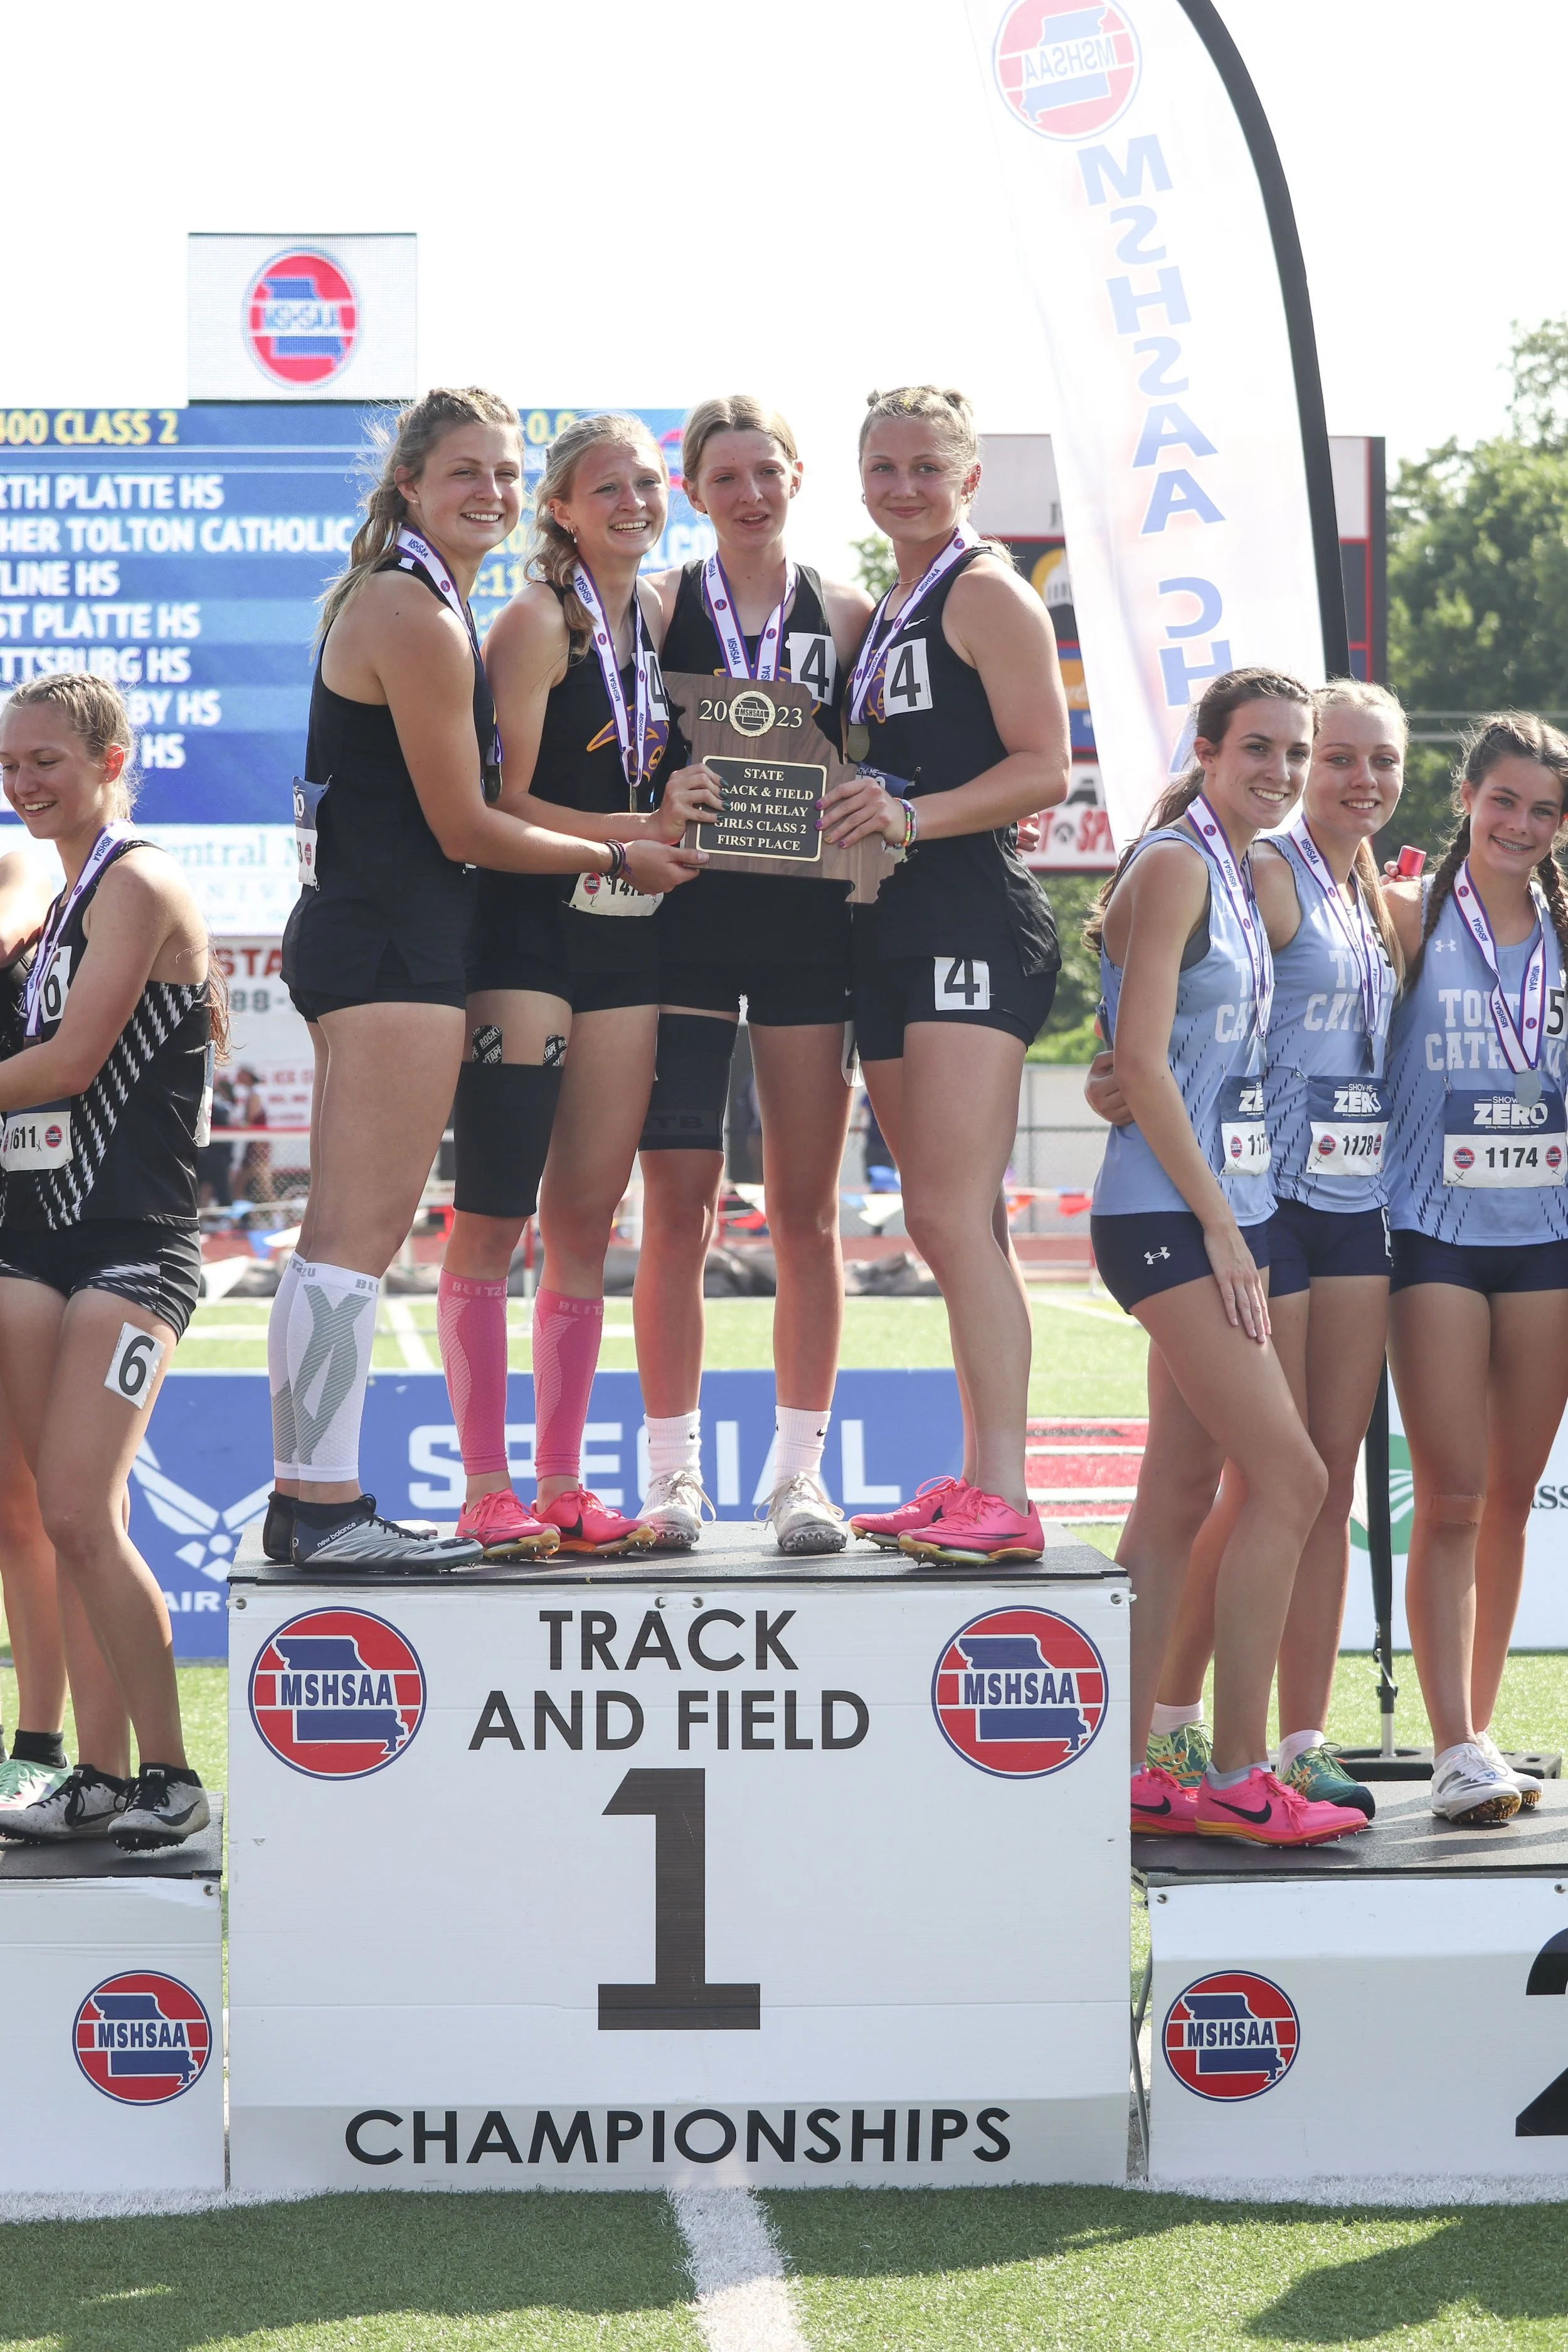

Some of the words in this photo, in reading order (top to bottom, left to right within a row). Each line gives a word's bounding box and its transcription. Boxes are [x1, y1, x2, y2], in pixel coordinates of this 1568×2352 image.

[54, 410, 152, 445] CLASS
[157, 410, 179, 444] 2
[55, 475, 174, 509] PLATTE
[179, 475, 224, 509] HS
[65, 517, 194, 553] TOLTON
[200, 517, 355, 553] CATHOLIC
[407, 538, 428, 559] MSHSAA
[75, 560, 120, 596] HS
[575, 575, 594, 604] MSHSAA
[918, 568, 941, 593] MSHSAA
[33, 602, 152, 638] PLATTE
[157, 602, 201, 638] HS
[146, 647, 191, 683] HS
[726, 638, 741, 665] MSHSAA
[867, 652, 881, 679] MSHSAA
[800, 638, 830, 699] 4
[890, 645, 921, 707] 4
[608, 672, 621, 702] MSHSAA
[176, 690, 221, 726] HS
[699, 699, 727, 721] 20
[739, 707, 764, 718] MSHSAA
[776, 706, 803, 728] 23
[140, 733, 186, 769] HS
[744, 768, 784, 781] STATE
[761, 787, 771, 797] &
[775, 788, 814, 801] FIELD
[750, 803, 762, 813] M
[765, 804, 808, 817] RELAY
[714, 817, 753, 830] GIRLS
[756, 820, 798, 834] CLASS
[800, 824, 807, 834] 2
[93, 835, 114, 861] MSHSAA
[717, 834, 755, 847] FIRST
[757, 837, 801, 851] PLACE
[1300, 838, 1320, 866] MSHSAA
[1222, 859, 1238, 887] MSHSAA
[1472, 917, 1489, 941] MSHSAA
[44, 951, 61, 1017] 6
[944, 958, 980, 1005] 4
[1528, 965, 1540, 992] MSHSAA
[1494, 1000, 1509, 1029] MSHSAA
[1547, 988, 1565, 1036] 5
[1333, 1091, 1382, 1113] ZERO
[1473, 1103, 1548, 1125] ZERO
[1343, 1135, 1374, 1156] 1178
[1485, 1147, 1538, 1168] 1174
[117, 1335, 156, 1396] 6
[408, 1419, 901, 1510] SPEIAL
[317, 1537, 331, 1548] new
[329, 1522, 356, 1540] balance
[539, 1608, 800, 1671] TRACK
[281, 1673, 394, 1707] MSHSAA
[964, 1672, 1077, 1705] MSHSAA
[467, 1690, 645, 1751] AND
[677, 1690, 870, 1751] FIELD
[597, 1767, 761, 2030] 1
[97, 2021, 187, 2049] MSHSAA
[1187, 2020, 1274, 2047] MSHSAA
[344, 2106, 1012, 2166] CHAMPIONSHIPS
